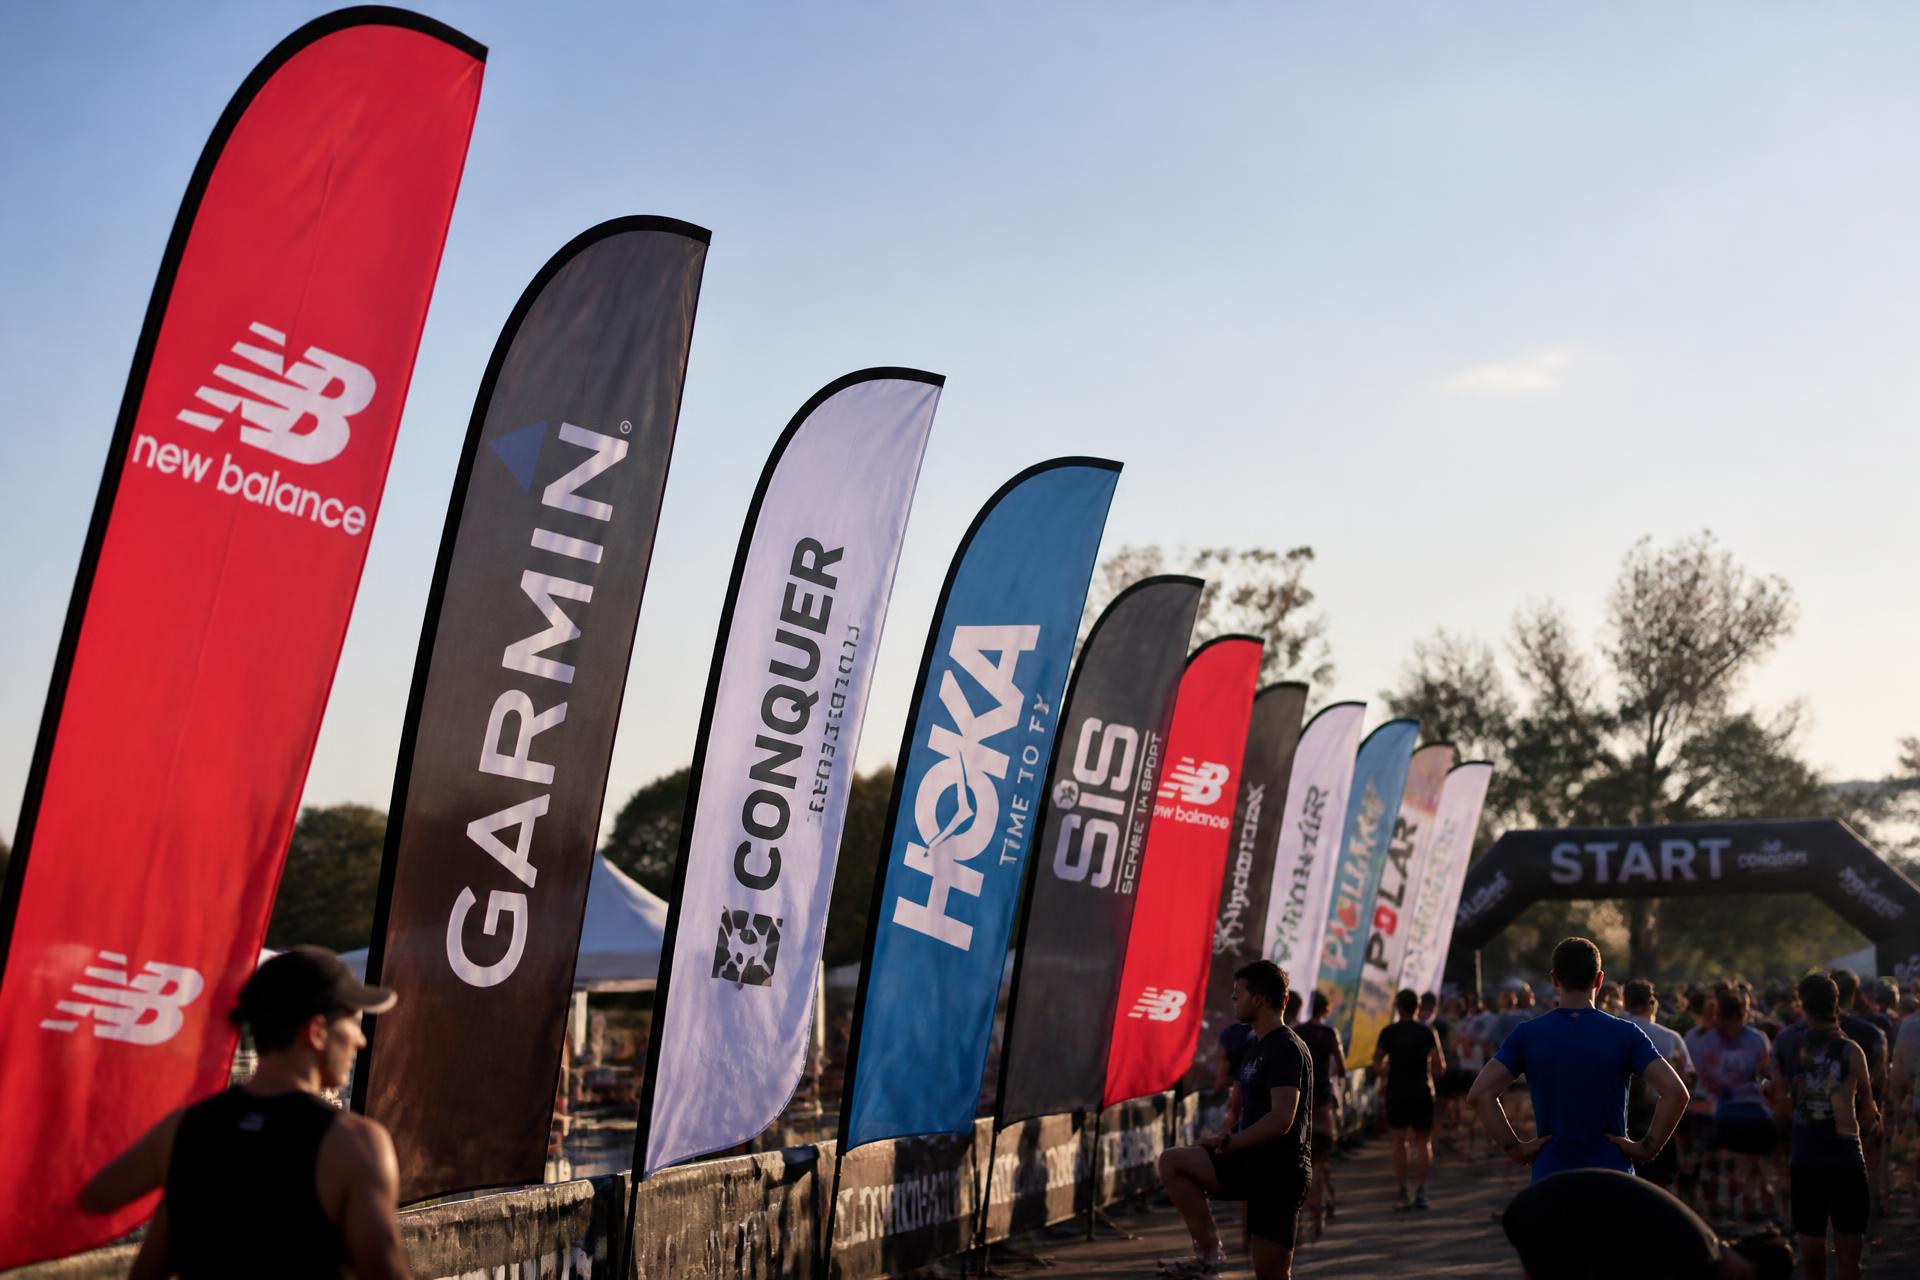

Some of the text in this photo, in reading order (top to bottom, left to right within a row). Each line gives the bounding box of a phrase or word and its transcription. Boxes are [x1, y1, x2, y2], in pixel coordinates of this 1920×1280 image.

[132, 434, 367, 536] new balance
[733, 537, 845, 891] CONQUER
[892, 624, 1041, 951] HOKA
[1000, 799, 1030, 866] TIME
[1017, 748, 1039, 785] TO
[1174, 805, 1230, 829] balance
[1365, 815, 1418, 972] POLAR
[1551, 838, 1732, 885] START
